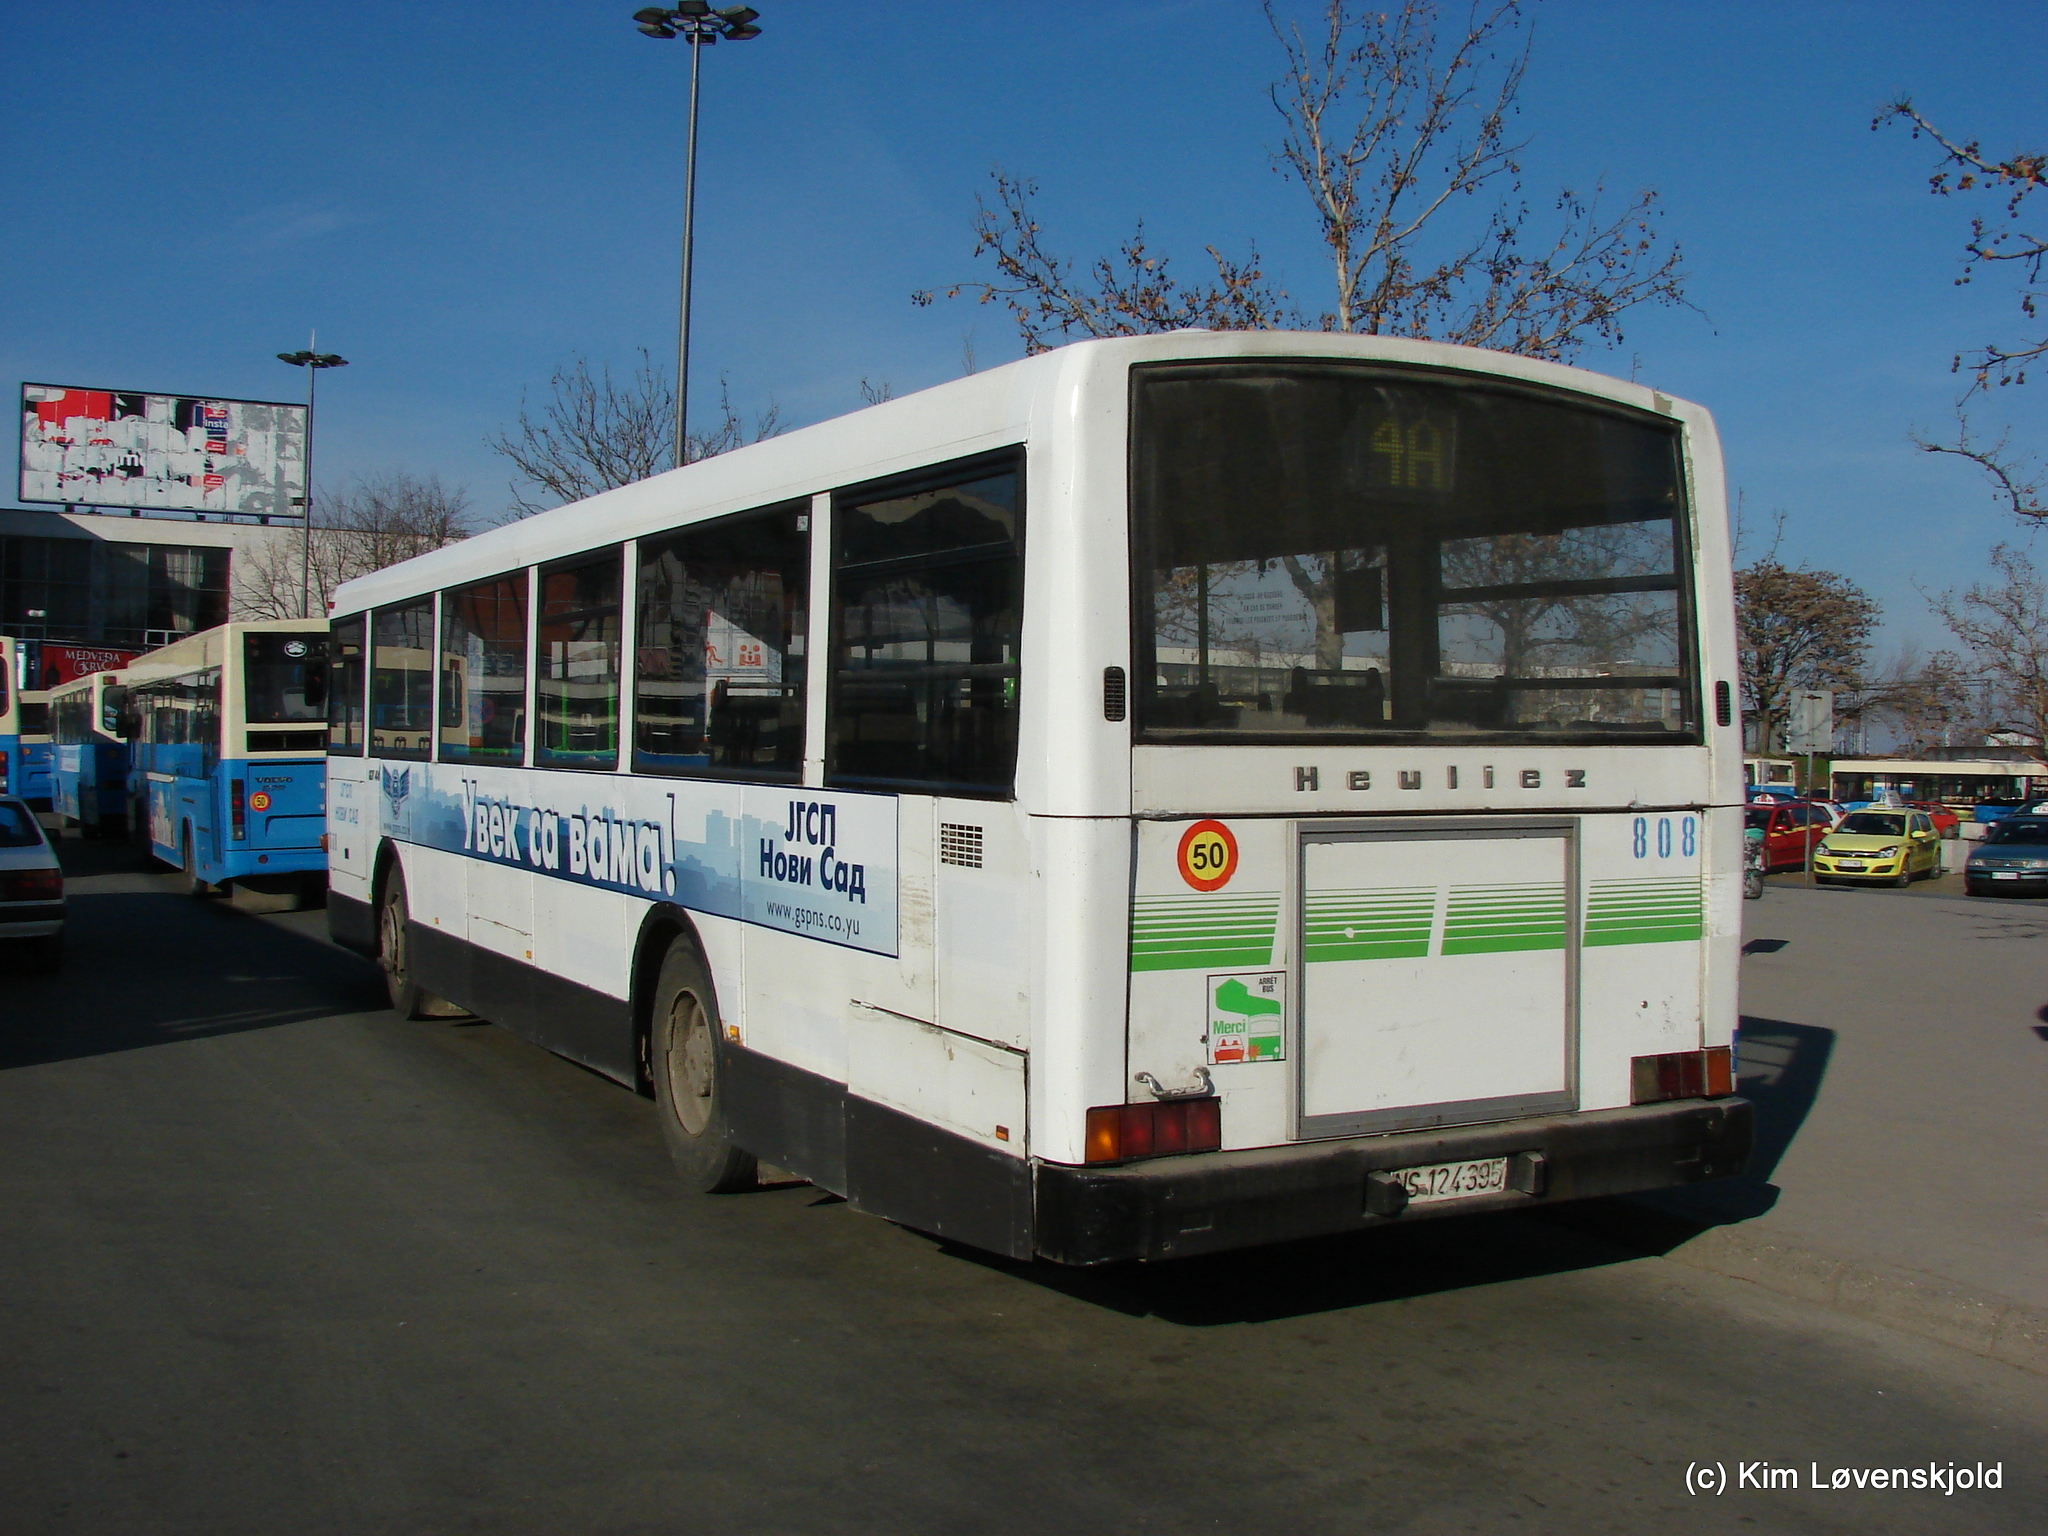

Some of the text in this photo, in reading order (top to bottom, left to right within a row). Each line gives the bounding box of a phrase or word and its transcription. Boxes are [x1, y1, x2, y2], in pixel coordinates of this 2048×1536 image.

[1293, 765, 1586, 791] Heuliez
[461, 778, 677, 897] Увек са вама!
[784, 800, 836, 846] ЈГСП
[1633, 816, 1695, 859] 808
[760, 838, 867, 904] Нови Сад
[1192, 842, 1224, 870] 50
[766, 901, 861, 940] www.gspns.co.yu
[1262, 985, 1275, 993] BUS
[1213, 1018, 1246, 1035] Merci
